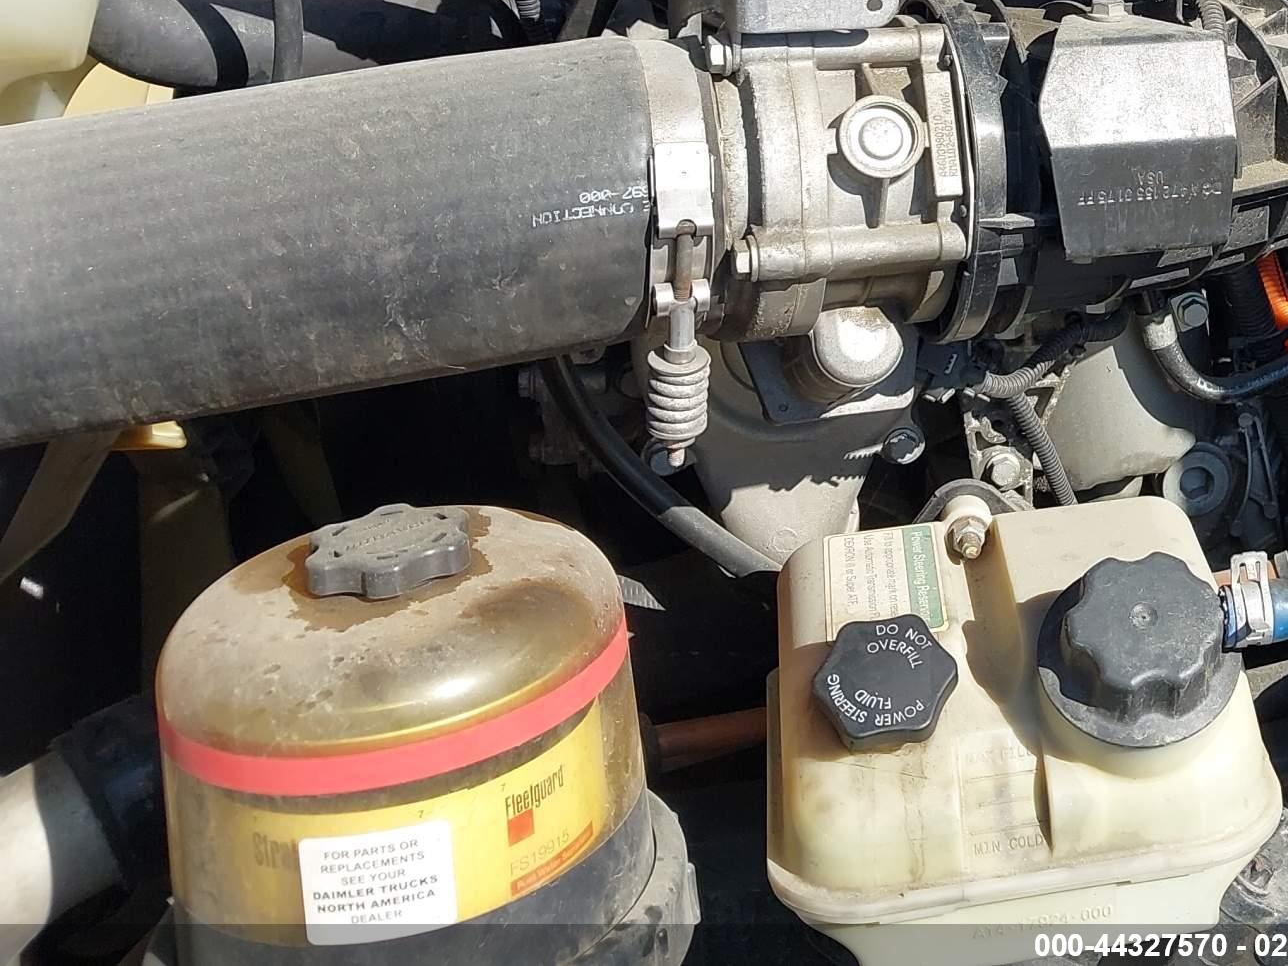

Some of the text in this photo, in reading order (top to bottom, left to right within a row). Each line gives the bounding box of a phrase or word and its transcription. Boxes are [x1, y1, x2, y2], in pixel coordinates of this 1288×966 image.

[1138, 170, 1164, 186] USA
[843, 537, 854, 561] DEXRON
[911, 531, 925, 553] Power
[912, 554, 927, 584] Steering
[876, 624, 933, 651] DO NOT
[866, 638, 924, 669] OVERFILL
[827, 674, 925, 727] POWER STEERING
[854, 689, 892, 710] FLUID
[505, 765, 564, 818] Fleetguard
[324, 839, 418, 861] FOR PARTS OR
[974, 834, 1045, 858] MIN COLD
[320, 851, 425, 874] REPLACEMENTS
[313, 874, 438, 901] DAIMLER TRUCKS
[341, 868, 406, 887] SEE YOUR
[317, 889, 436, 914] NORTH AMERICA
[351, 909, 403, 925] DEALER
